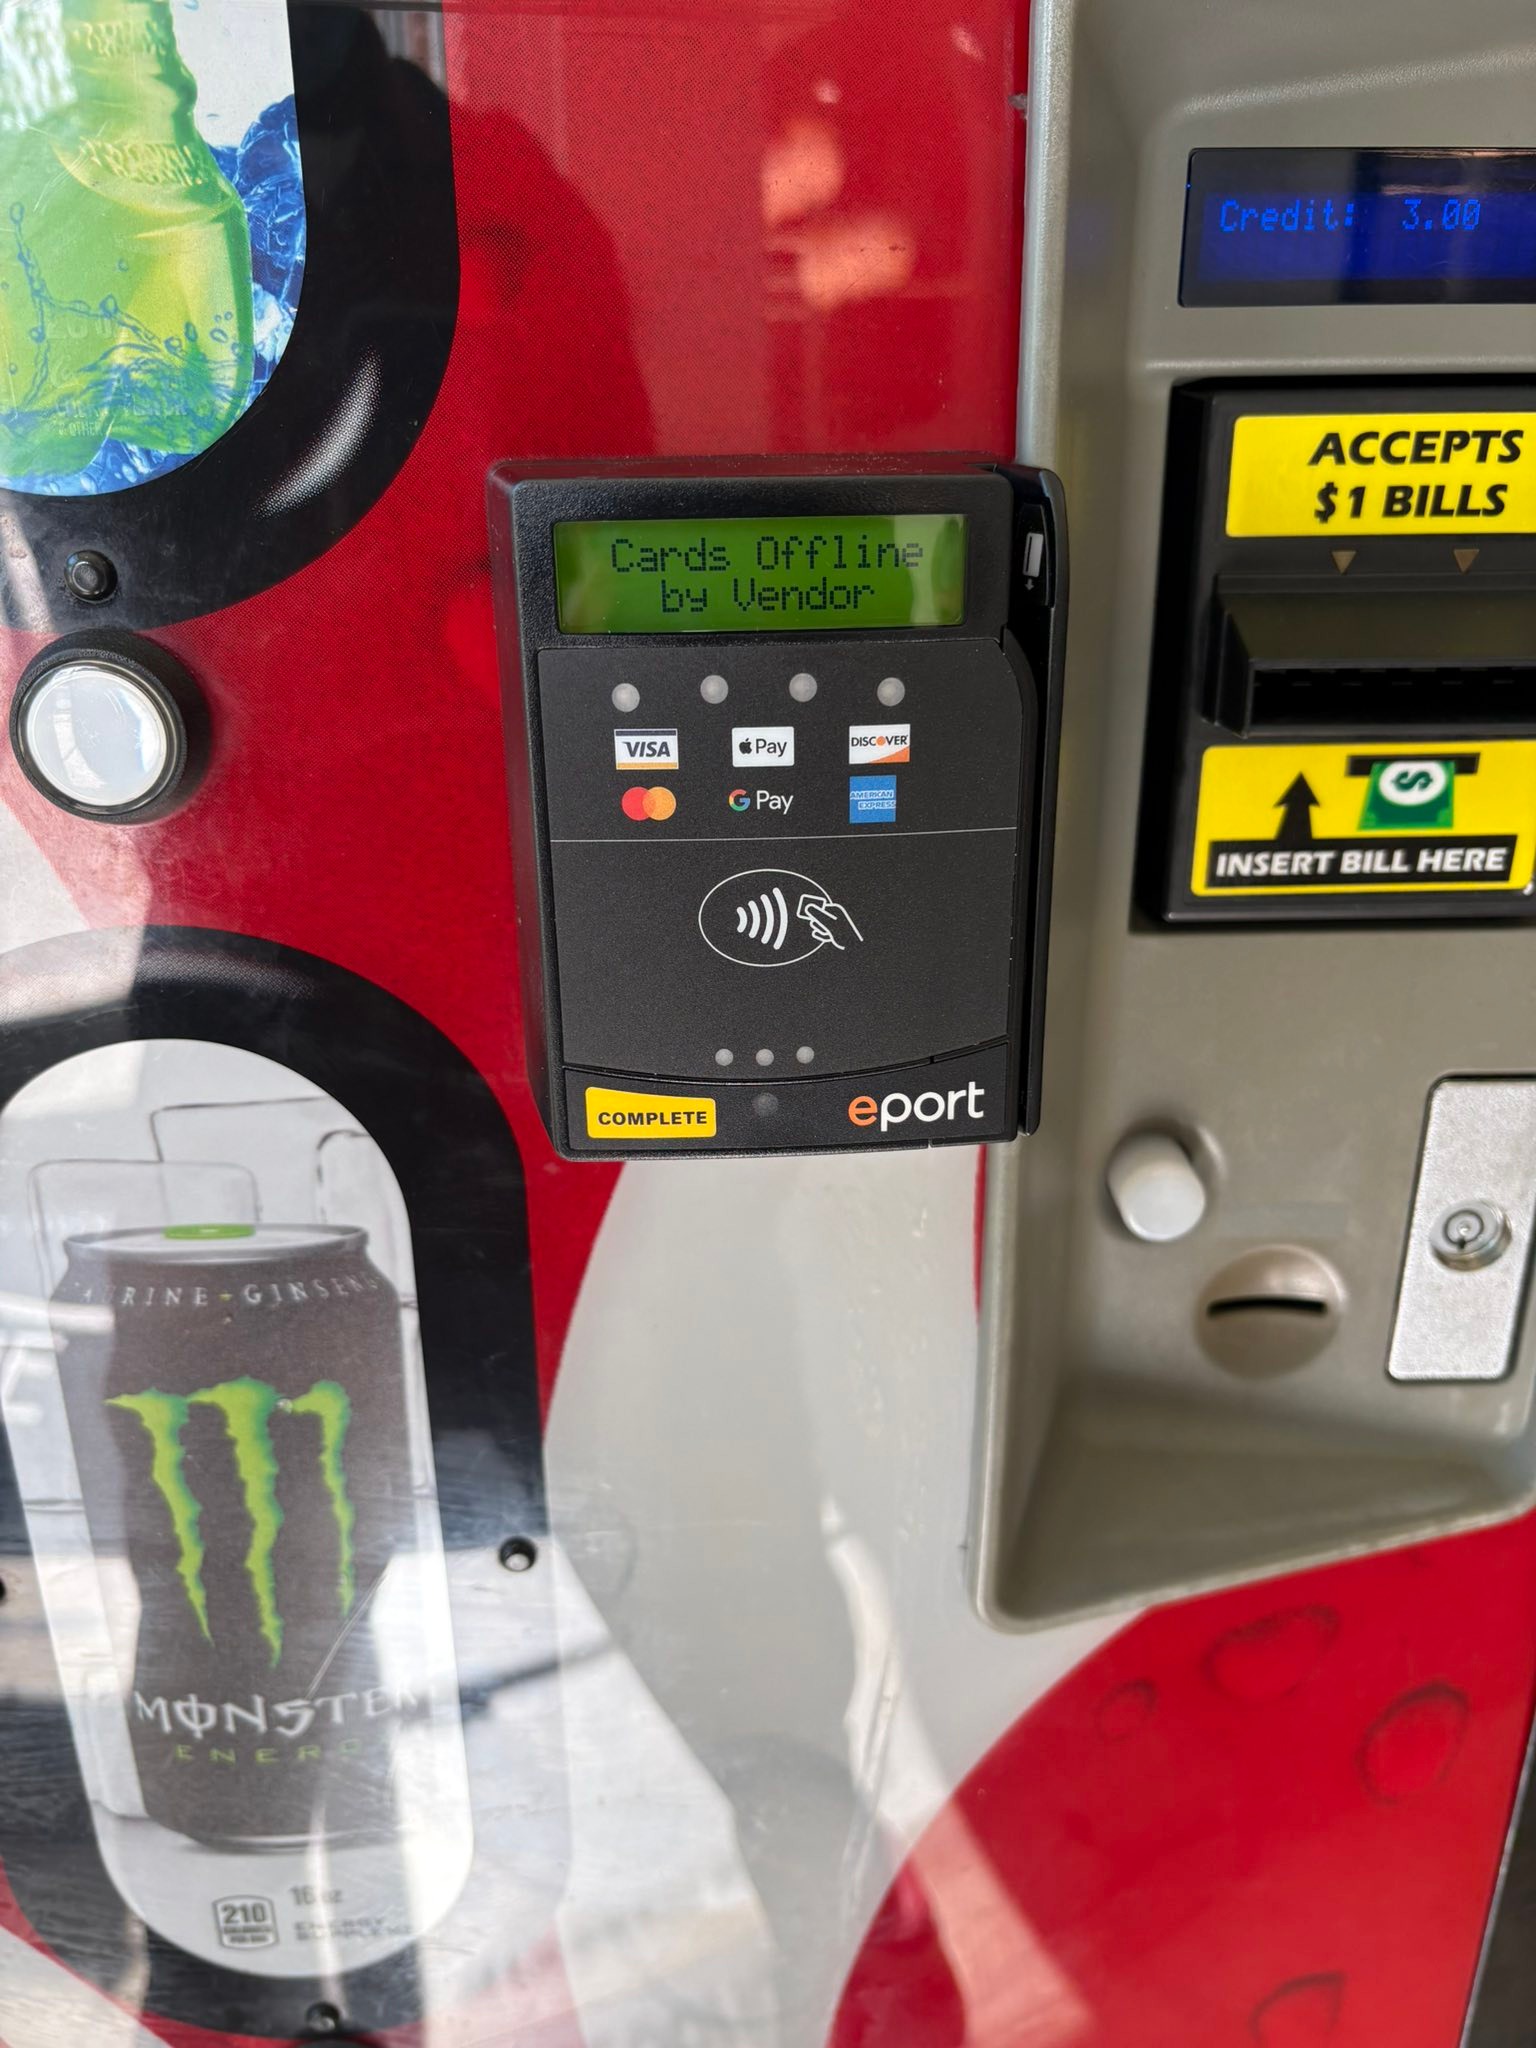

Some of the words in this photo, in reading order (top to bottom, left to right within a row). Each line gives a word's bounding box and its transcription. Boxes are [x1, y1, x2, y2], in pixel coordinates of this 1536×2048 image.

[1219, 199, 1354, 232] Credit:
[1402, 199, 1481, 231] 3.00
[1307, 429, 1524, 466] ACCEPTS
[1314, 481, 1366, 523] $1
[1382, 484, 1508, 518] BILLS
[611, 537, 731, 573] Cards
[756, 534, 924, 571] Offline
[661, 579, 708, 613] by
[733, 576, 875, 612] Vendor
[622, 740, 671, 758] VISA
[755, 738, 787, 757] Pay
[850, 734, 909, 748] DISCOVER
[728, 788, 751, 812] G
[756, 789, 794, 815] Pay
[850, 790, 894, 800] AMERICAN
[858, 801, 896, 810] EXPRESS
[1216, 851, 1334, 878] INSERT
[1340, 850, 1410, 875] BILL
[1417, 847, 1508, 874] HERE
[597, 1110, 708, 1126] COMPLETE
[847, 1081, 986, 1132] eport
[175, 1738, 363, 1765] ENERG
[221, 1903, 267, 1925] 210
